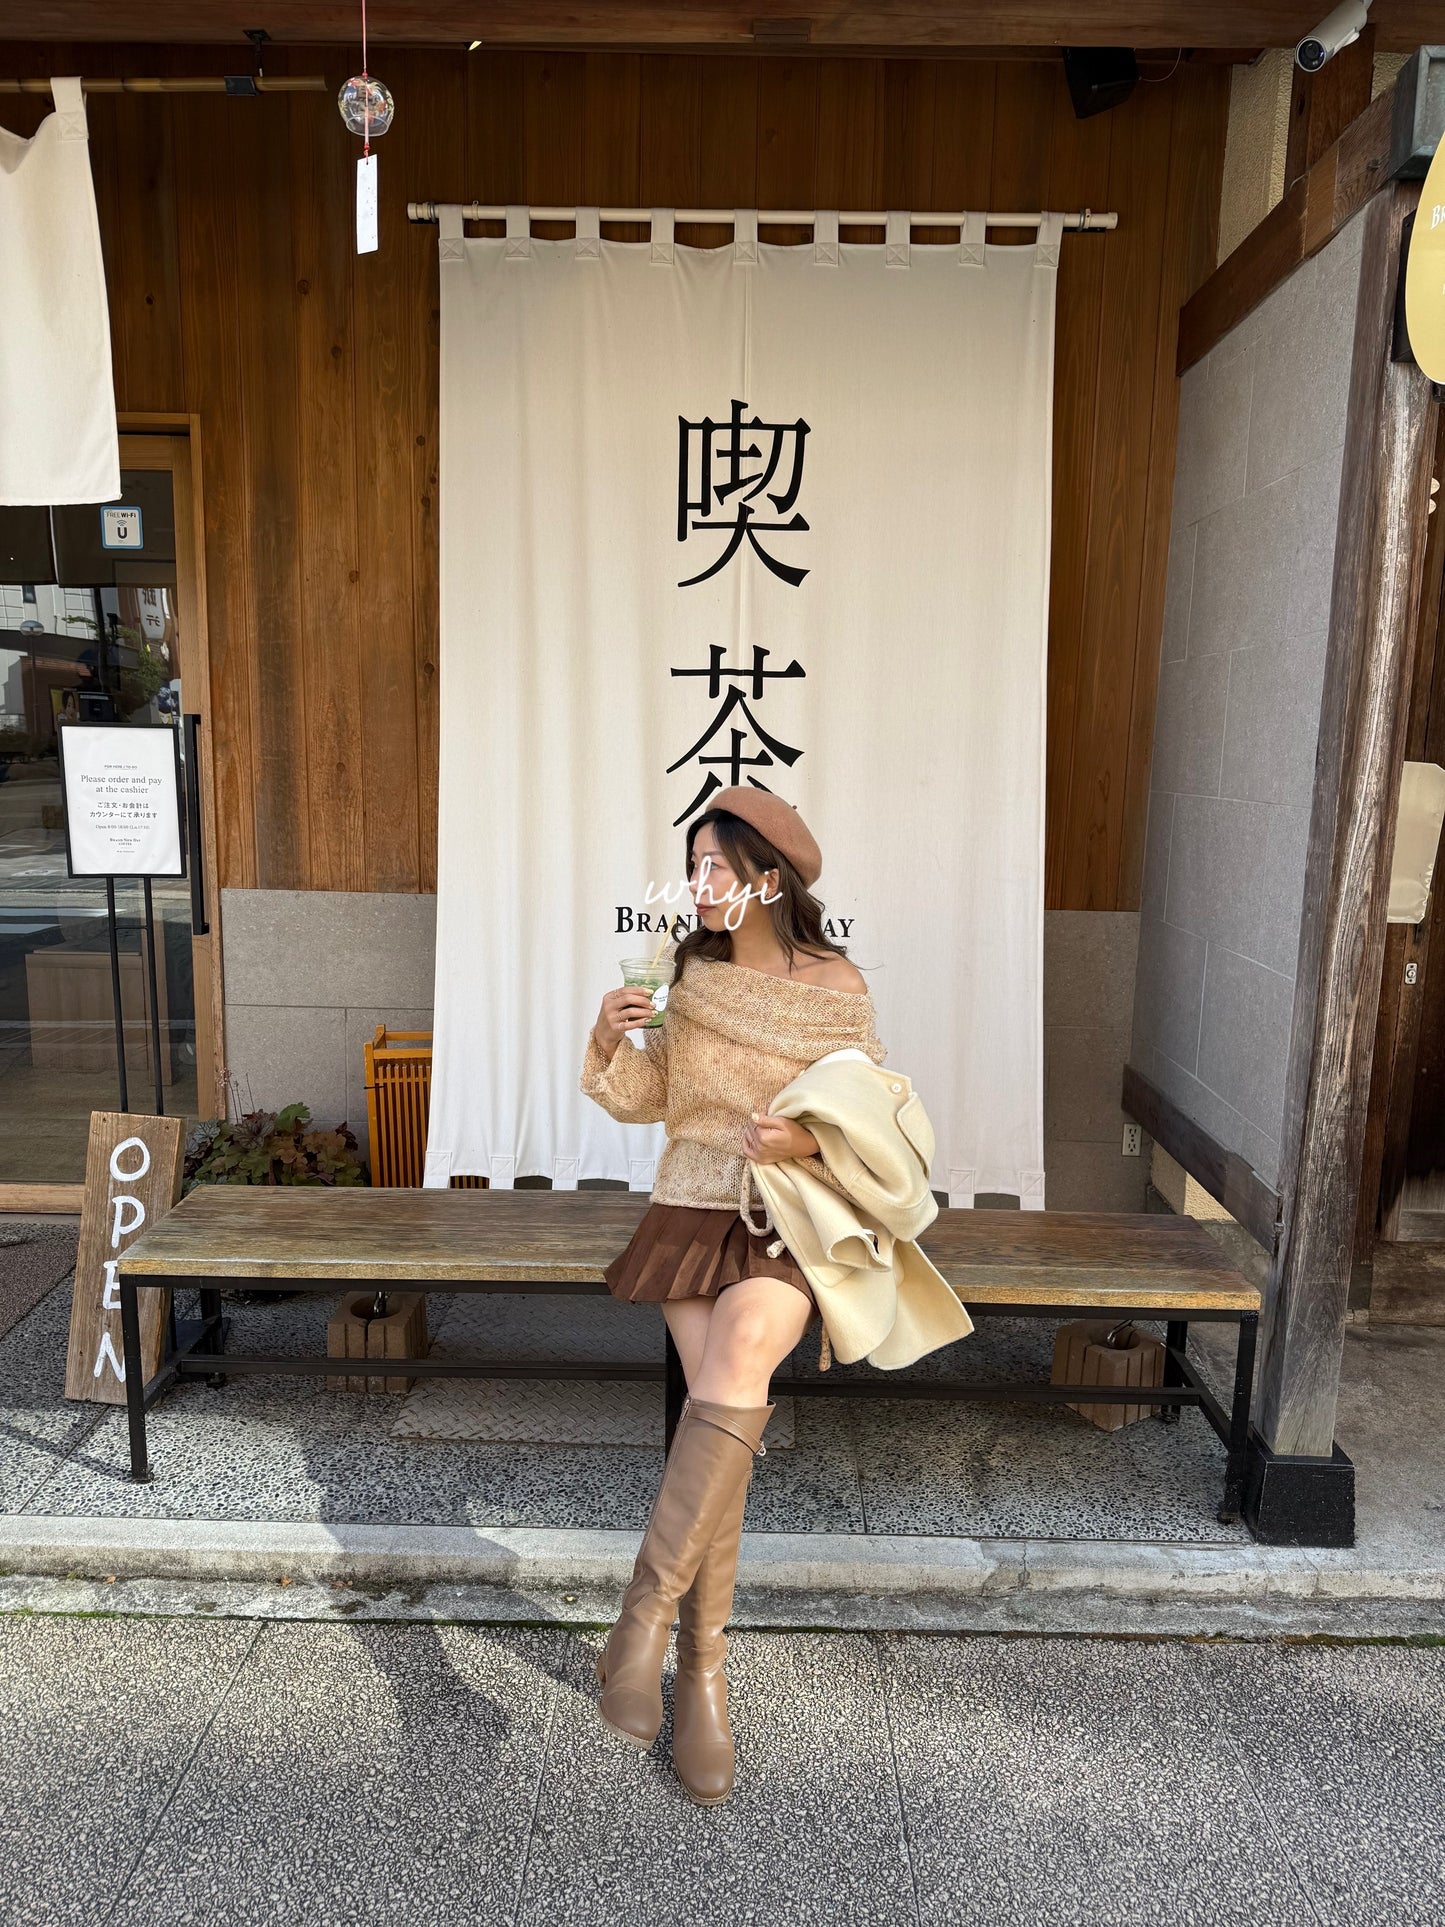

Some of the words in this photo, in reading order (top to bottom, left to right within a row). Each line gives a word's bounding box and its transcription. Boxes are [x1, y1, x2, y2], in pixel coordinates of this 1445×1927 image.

[666, 399, 812, 827] 喫茶
[81, 774, 106, 783] Please
[108, 776, 129, 784] order
[131, 776, 146, 784] and
[148, 777, 162, 786] pay
[105, 785, 118, 793] the
[120, 785, 149, 794] cashier
[89, 811, 158, 819] カウンターにて承ります
